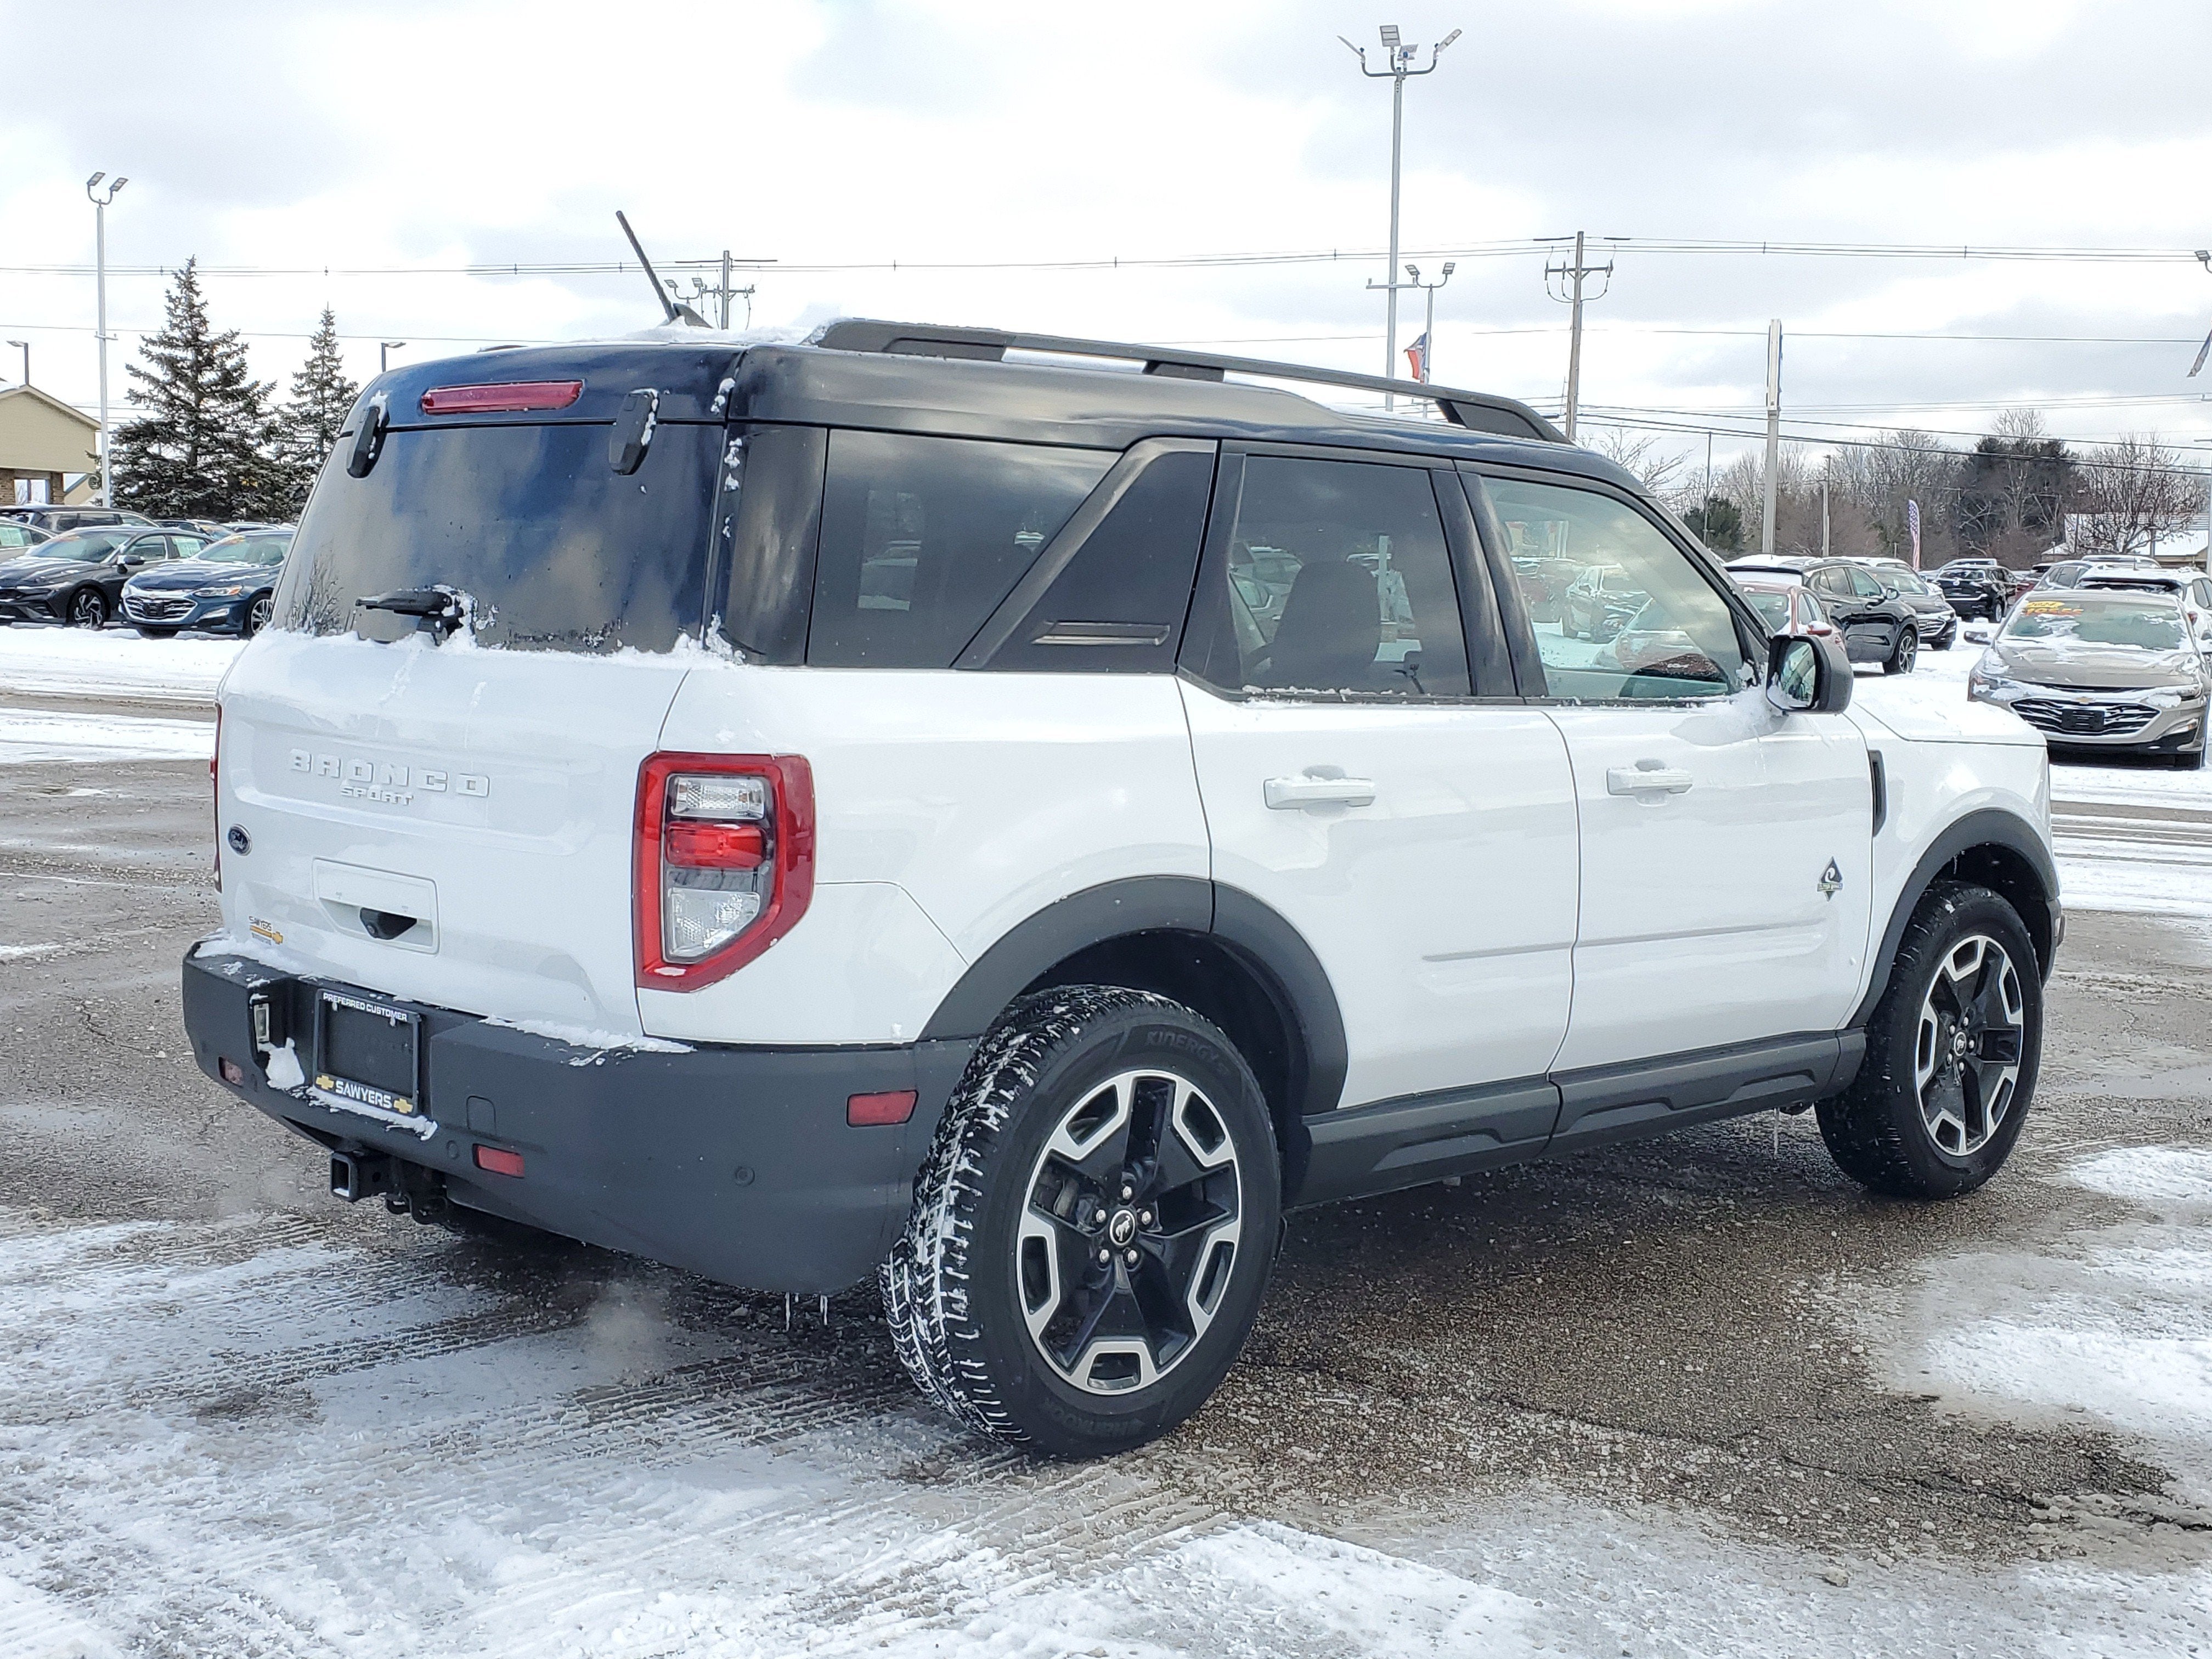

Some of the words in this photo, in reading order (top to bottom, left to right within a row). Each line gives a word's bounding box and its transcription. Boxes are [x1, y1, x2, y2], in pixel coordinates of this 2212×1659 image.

[290, 748, 490, 798] BRONCO
[340, 785, 414, 805] SPORT
[323, 992, 366, 1011] PREFERRED
[366, 1003, 408, 1022] CUSTOMER
[335, 1080, 393, 1109] SAWYERS
